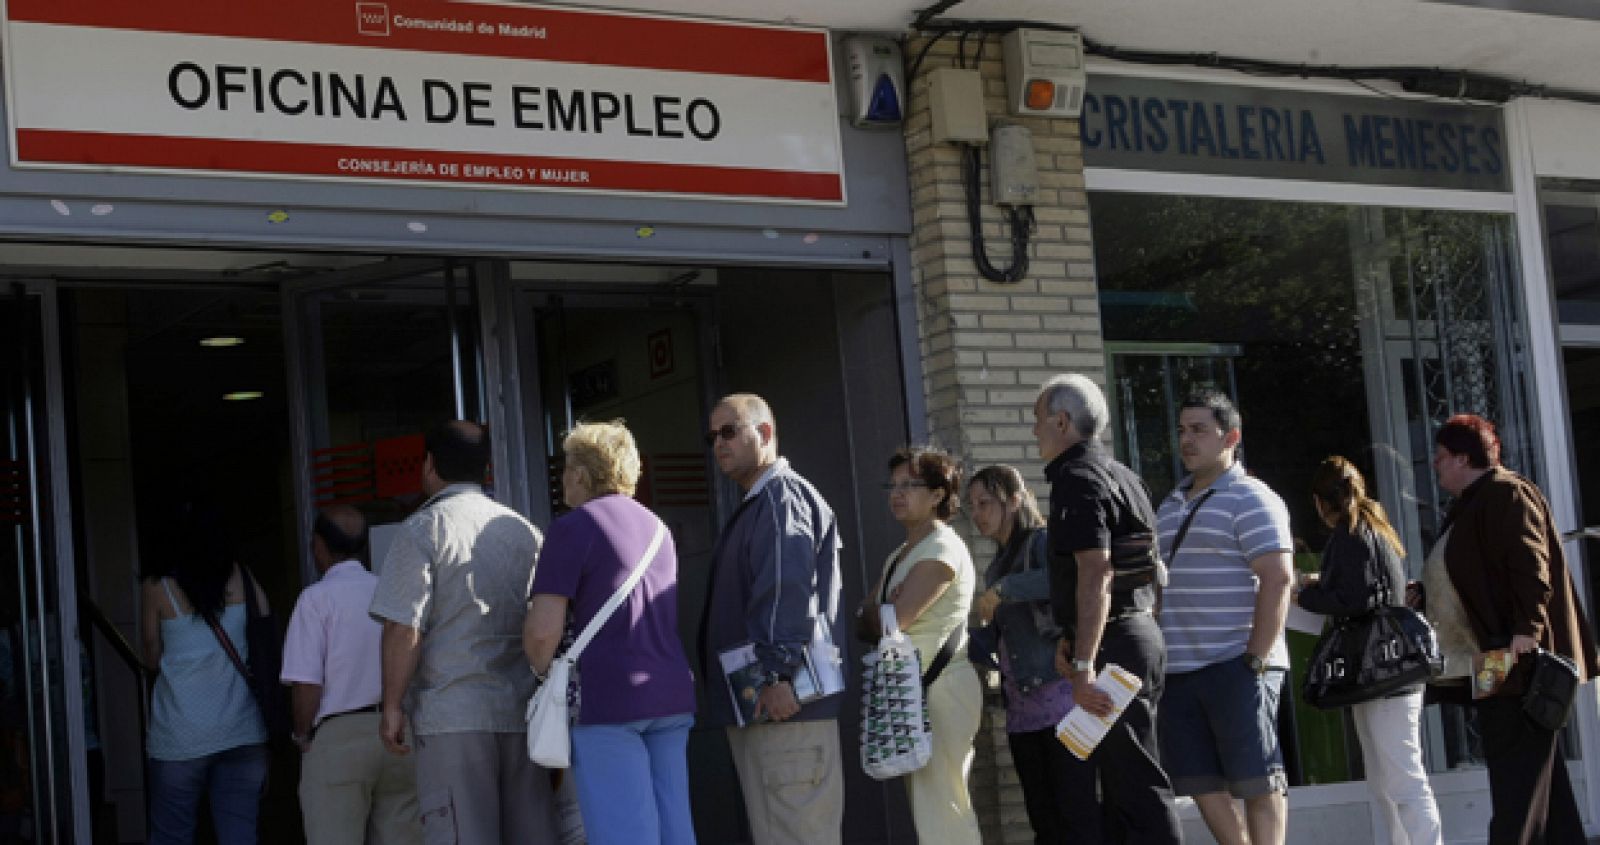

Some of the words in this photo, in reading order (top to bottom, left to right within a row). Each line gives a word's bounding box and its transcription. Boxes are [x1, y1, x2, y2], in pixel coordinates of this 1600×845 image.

[393, 15, 474, 33] Comunidad
[478, 23, 494, 35] de
[498, 23, 546, 39] Madrid
[168, 61, 408, 121] OFICINA
[422, 78, 495, 127] DE
[511, 84, 721, 142] EMPLEO
[1080, 92, 1327, 165] CRISTALERIA
[1343, 113, 1504, 175] MENESES
[337, 158, 436, 175] CONSEJERÍA
[440, 163, 459, 177] DE
[463, 164, 523, 180] EMPLEO
[527, 168, 537, 180] Y
[540, 168, 590, 182] MUJER
